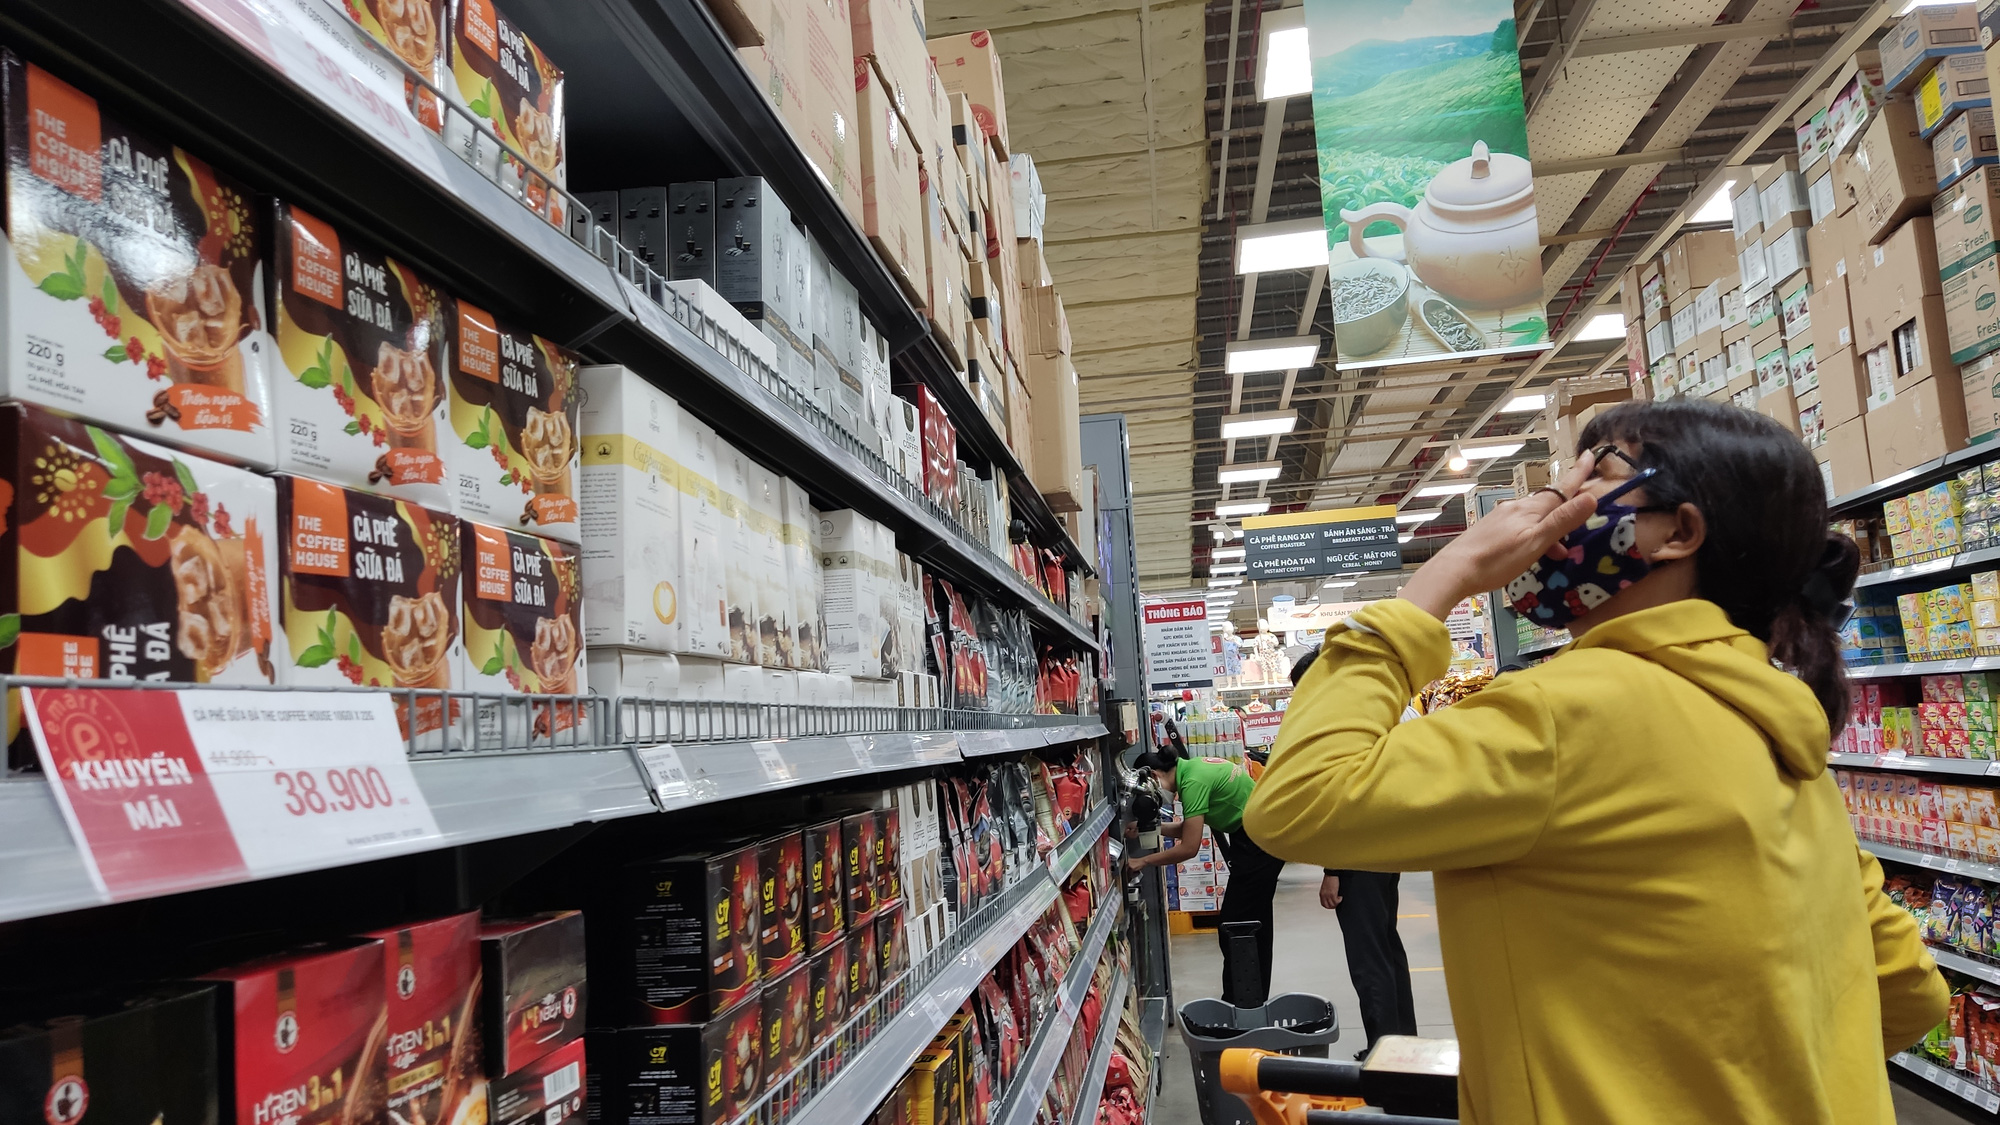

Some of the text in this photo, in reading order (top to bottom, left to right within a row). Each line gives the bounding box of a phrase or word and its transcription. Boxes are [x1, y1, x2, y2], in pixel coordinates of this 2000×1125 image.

[467, 22, 492, 51] HOUSE
[468, 10, 496, 41] COFFEE
[498, 20, 527, 63] CÀ PHÊ
[518, 65, 530, 92] ĐÁ
[35, 108, 66, 138] THE
[35, 131, 101, 174] COFFEE
[108, 135, 170, 197] CÀ PHÊ
[35, 151, 89, 190] HOUSE
[1964, 229, 1990, 252] Fresh
[296, 255, 340, 286] COFFEE
[345, 252, 388, 296] CÀ PHÊ
[297, 272, 335, 299] HOUSE
[347, 286, 393, 332] SỮA ĐÁ
[462, 327, 480, 343] THE
[27, 341, 52, 359] 220
[56, 353, 64, 366] g
[462, 341, 496, 364] COFFEE
[501, 333, 536, 369] CÀ PHÊ
[462, 356, 492, 375] HOUSE
[502, 363, 539, 399] SỮA ĐÁ
[290, 423, 308, 436] 220
[459, 478, 473, 489] 220
[297, 515, 322, 532] THE
[353, 510, 398, 547] CÀ PHÊ
[1323, 528, 1345, 538] BÁNH
[1357, 525, 1377, 535] SÁNG
[1381, 524, 1396, 533] TRÀ
[296, 533, 346, 552] COFFEE
[1249, 532, 1316, 544] CÀ PHÊ RANG XAY
[1279, 541, 1306, 549] ROASTERS
[296, 551, 339, 569] HOUSE
[355, 546, 404, 583] SỮA ĐÁ
[479, 551, 495, 565] THE
[513, 547, 543, 577] CÀ PHÊ
[1252, 556, 1316, 569] CÀ PHÊ HÒA TAN
[1343, 551, 1360, 562] CỐC
[1363, 551, 1379, 562] MẬT
[1379, 550, 1397, 559] ONG
[479, 566, 510, 583] COFFEE
[479, 580, 506, 595] HOUSE
[514, 577, 546, 607] SỮA ĐÁ
[1147, 604, 1204, 620] THÔNG BÁO
[193, 708, 207, 722] CÀ
[208, 706, 226, 722] PHÊ
[260, 710, 276, 722] THE
[277, 710, 307, 722] COFFEE
[308, 710, 333, 722] HOUSE
[70, 751, 193, 791] KHUYẾN
[274, 766, 394, 817] 38.900
[122, 794, 183, 831] MÃI
